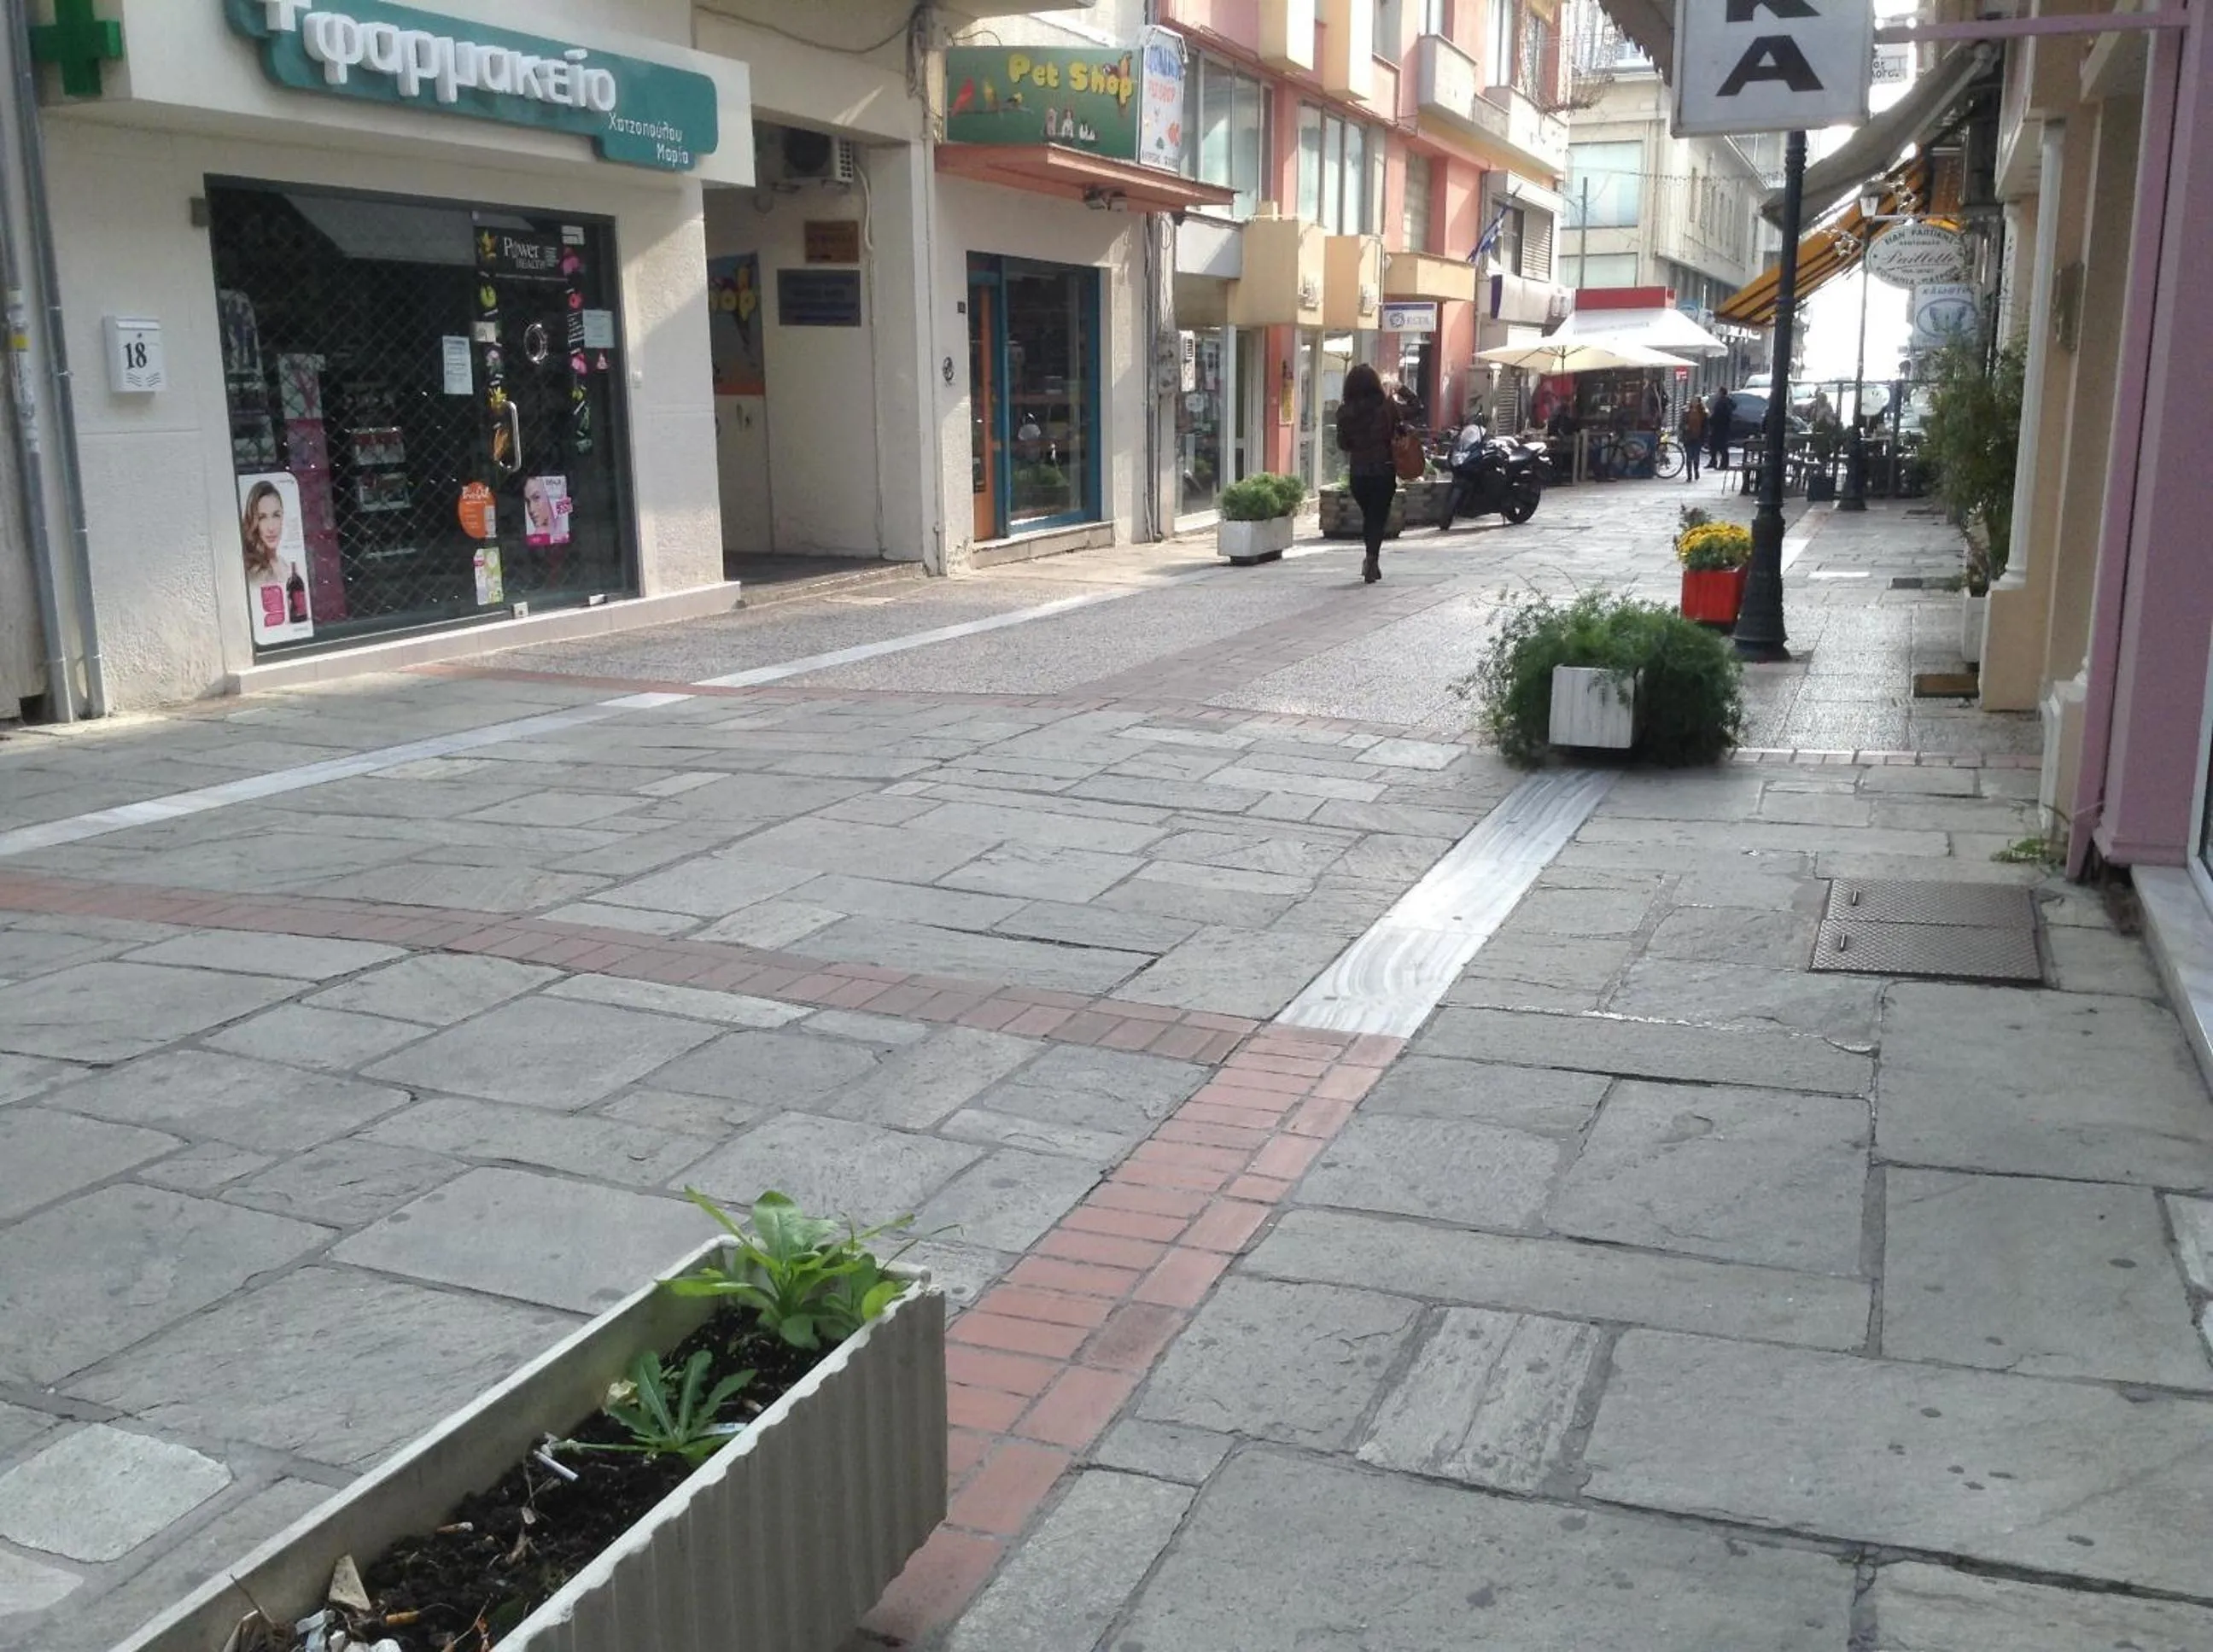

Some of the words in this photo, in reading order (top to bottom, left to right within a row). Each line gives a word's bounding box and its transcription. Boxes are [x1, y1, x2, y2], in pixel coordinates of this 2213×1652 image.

[303, 12, 616, 111] φαρμακείο
[1007, 53, 1060, 88] Pet
[1068, 61, 1134, 105] Shop
[124, 341, 148, 369] 18
